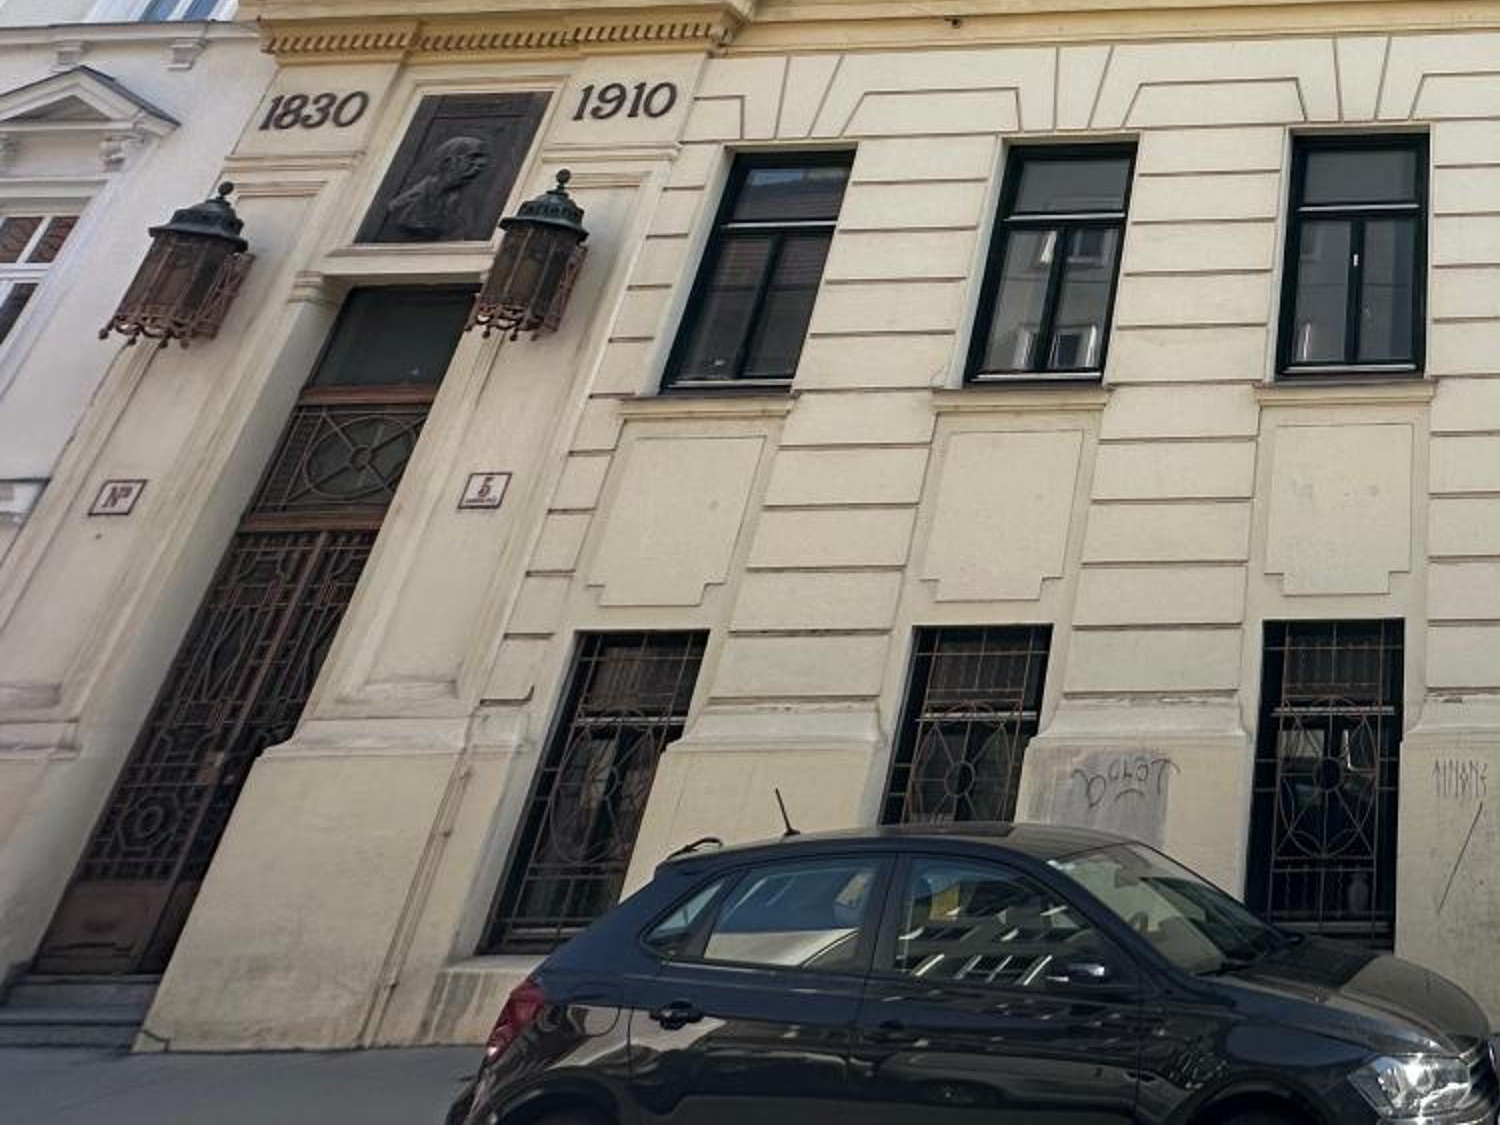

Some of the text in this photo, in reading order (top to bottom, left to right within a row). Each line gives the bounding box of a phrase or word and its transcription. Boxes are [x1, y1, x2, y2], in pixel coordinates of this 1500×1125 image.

[259, 90, 369, 130] 1830
[573, 81, 677, 121] 1910
[478, 477, 494, 497] 5
